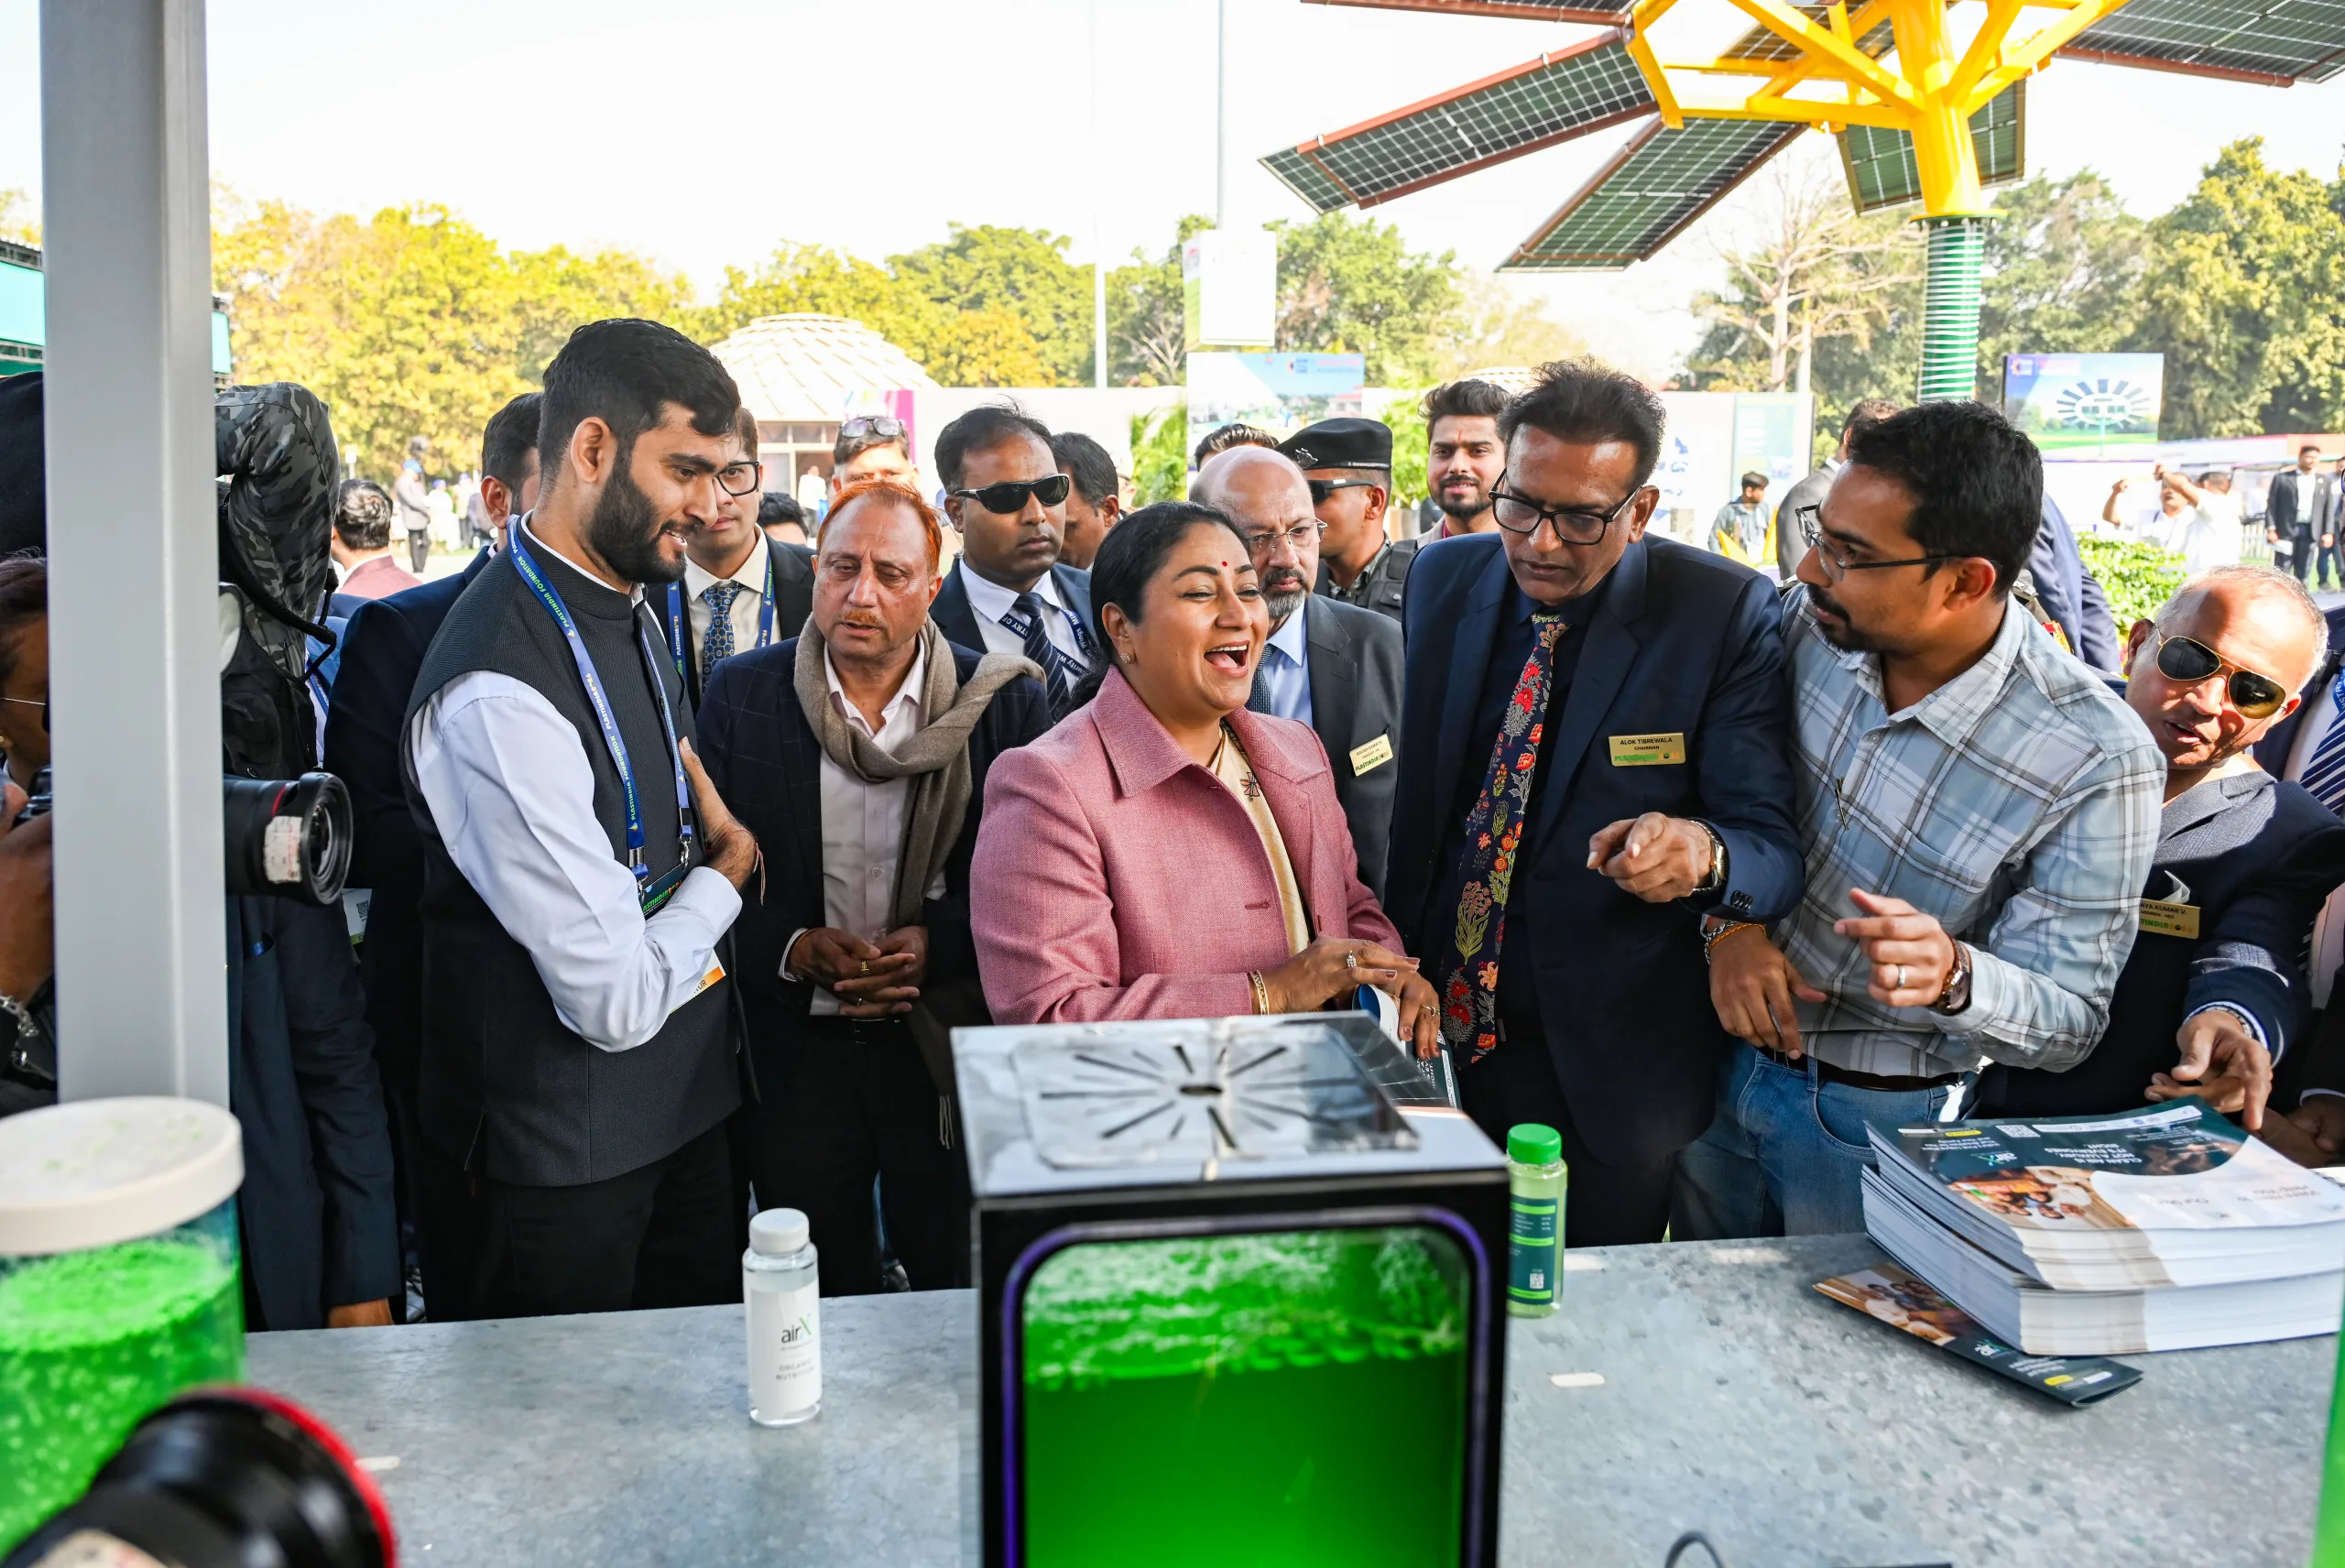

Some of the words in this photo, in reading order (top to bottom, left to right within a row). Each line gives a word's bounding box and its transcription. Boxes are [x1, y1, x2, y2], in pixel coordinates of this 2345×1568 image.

[517, 555, 547, 593] FOUNDATION
[543, 593, 570, 628] PLASTINDIA
[627, 781, 637, 821] PLASTINDIA
[2154, 905, 2179, 914] KUMAR
